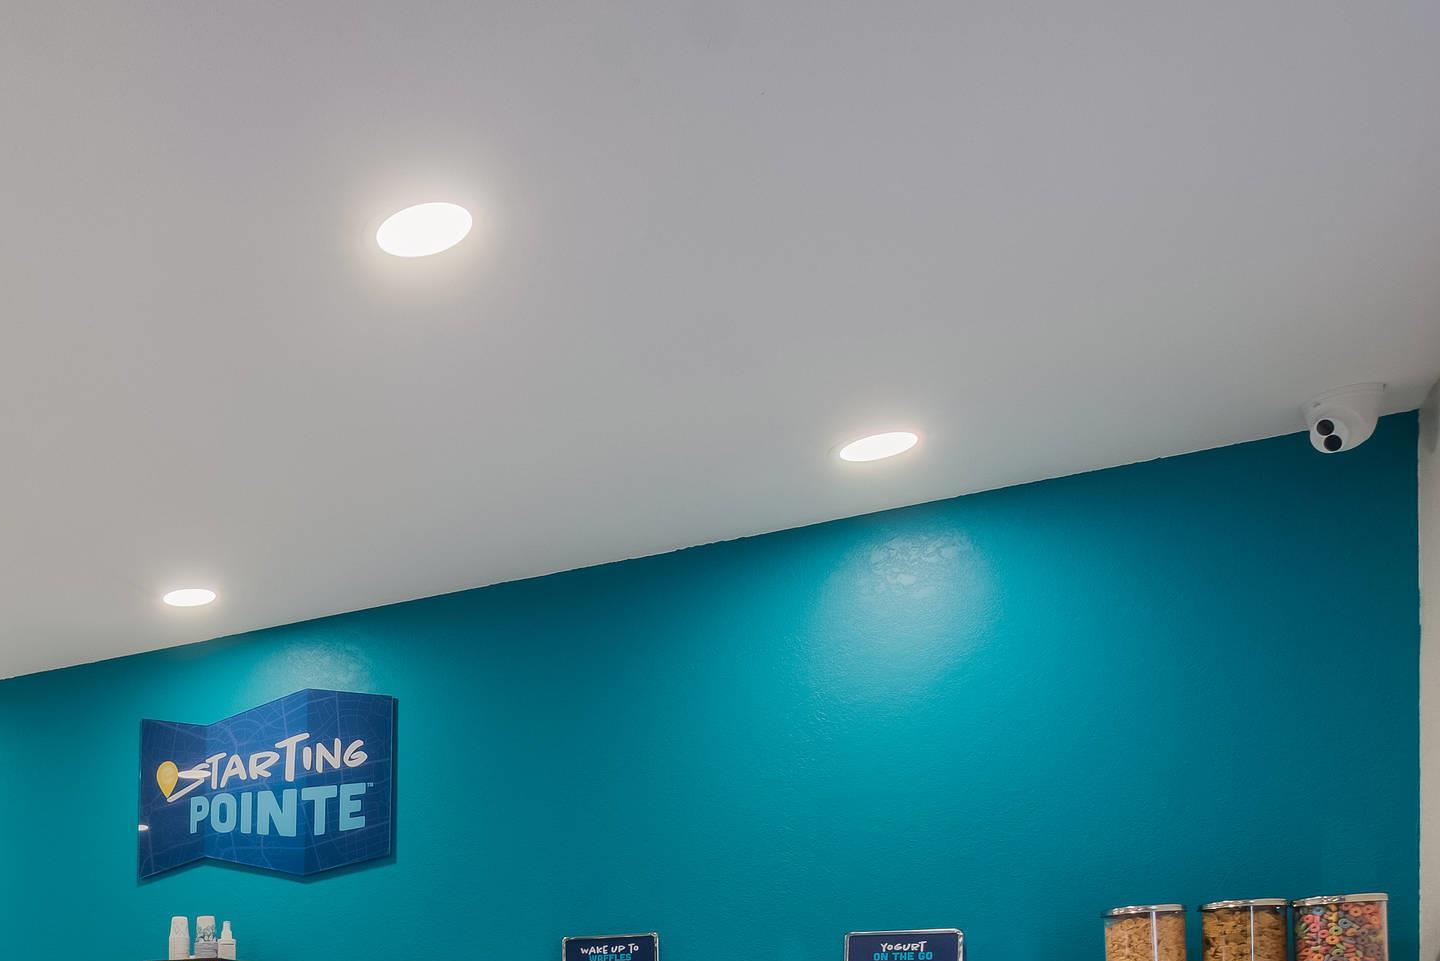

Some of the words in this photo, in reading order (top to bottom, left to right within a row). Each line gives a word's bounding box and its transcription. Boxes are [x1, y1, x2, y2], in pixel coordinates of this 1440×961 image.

[167, 732, 368, 803] STARTING
[189, 782, 366, 837] POINTE
[580, 945, 609, 955] WAKE
[611, 945, 626, 953] UP
[873, 952, 888, 961] ON
[892, 952, 915, 961] THE
[917, 951, 933, 961] GO
